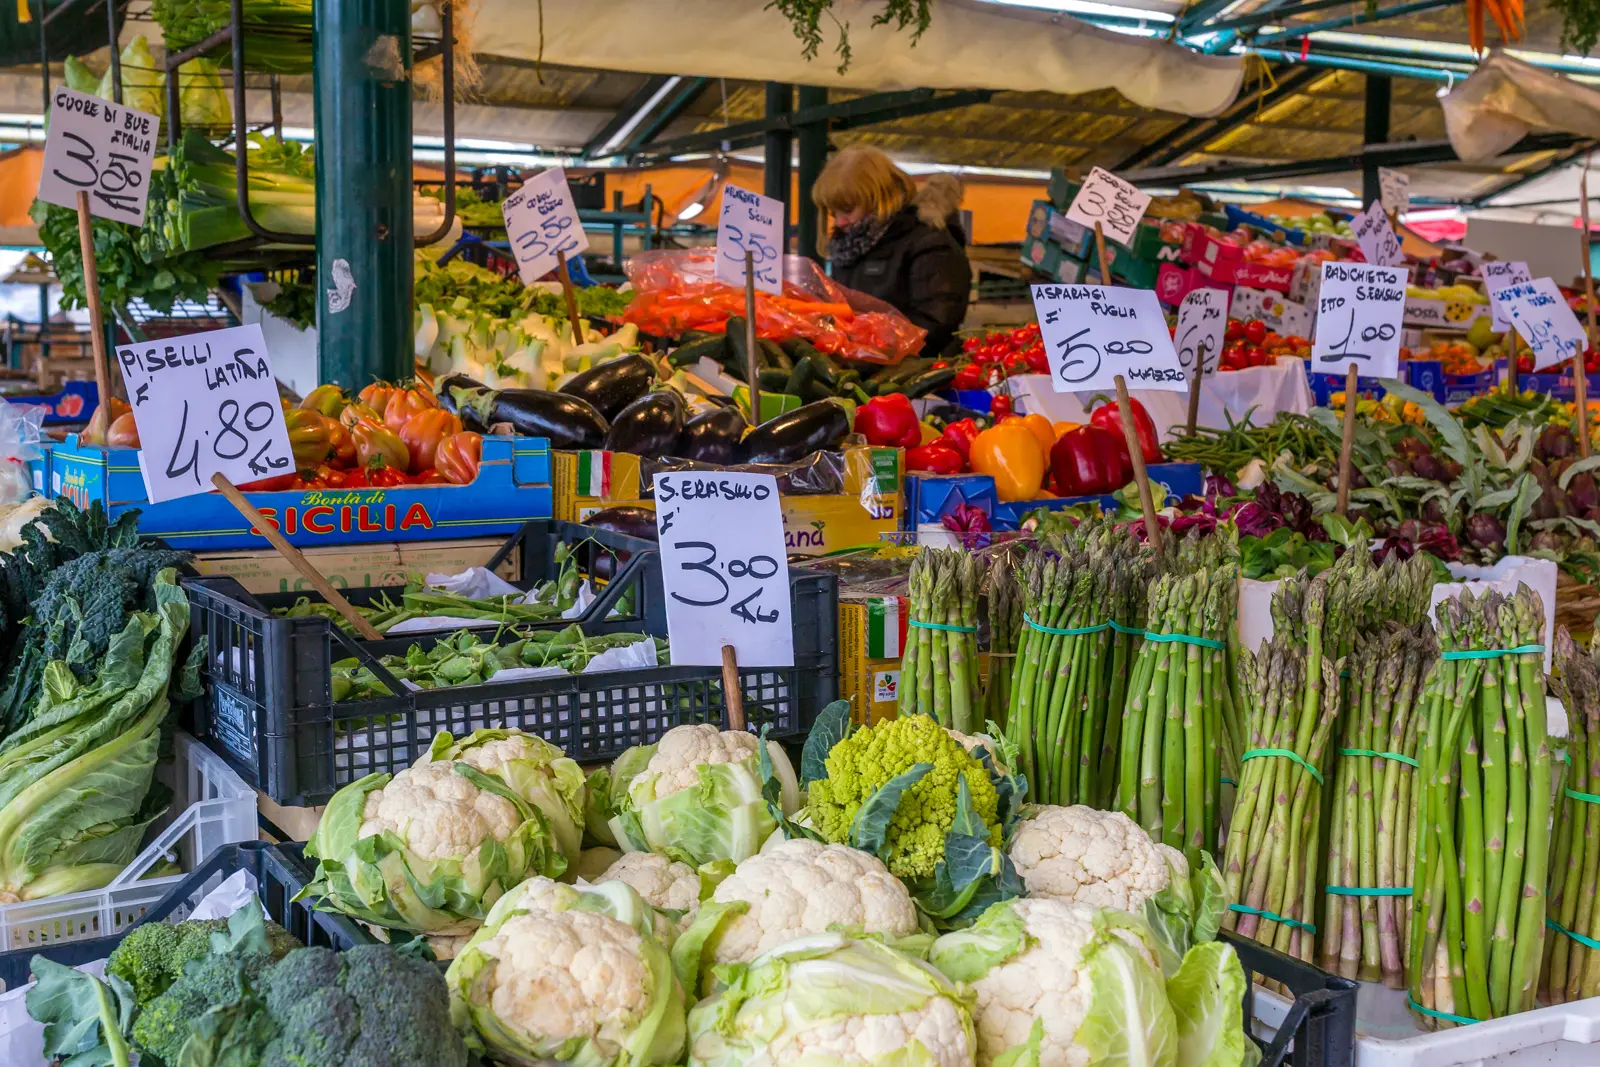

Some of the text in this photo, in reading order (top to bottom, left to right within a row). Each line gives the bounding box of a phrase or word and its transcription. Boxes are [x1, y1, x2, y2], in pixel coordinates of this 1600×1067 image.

[56, 93, 150, 135] CUORE DI BUE
[1035, 286, 1106, 301] ASPARAGI
[1090, 301, 1138, 320] PUGLIA
[1321, 297, 1346, 314] ETTO
[119, 342, 212, 378] PISELLI
[300, 490, 387, 507] Bontà di
[249, 502, 434, 537] SICILIA
